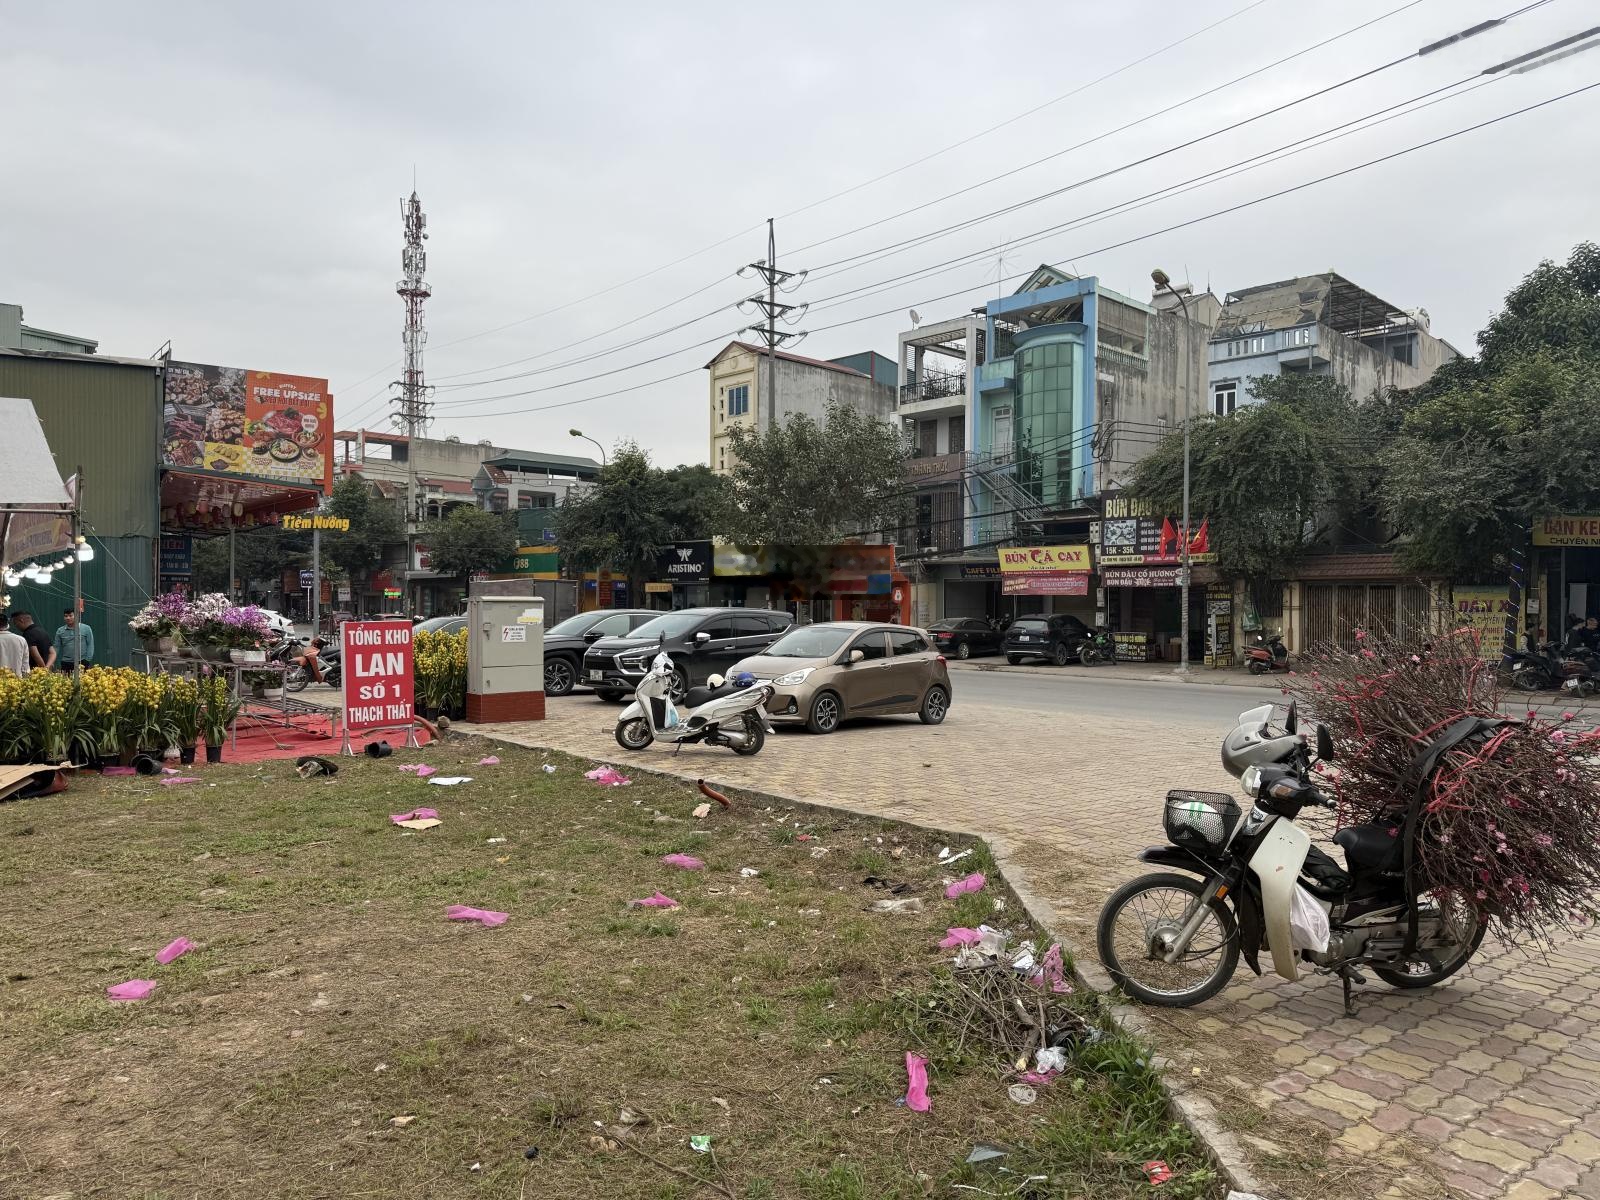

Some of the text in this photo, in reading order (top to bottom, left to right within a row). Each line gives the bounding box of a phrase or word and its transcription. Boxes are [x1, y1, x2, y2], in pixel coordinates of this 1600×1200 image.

[253, 386, 281, 398] FREE
[283, 390, 321, 402] UPSIZE
[1105, 495, 1128, 518] BÚN
[1550, 537, 1588, 545] CHUYÊN
[1057, 551, 1082, 561] CAY
[1122, 546, 1134, 554] 35K
[667, 563, 702, 574] ARISTINO
[1105, 570, 1120, 578] BÚN
[348, 624, 410, 646] TỔNG KHO
[355, 652, 404, 677] LAN
[360, 680, 400, 700] SỐ 1
[349, 698, 412, 726] THẠCH THẤT
